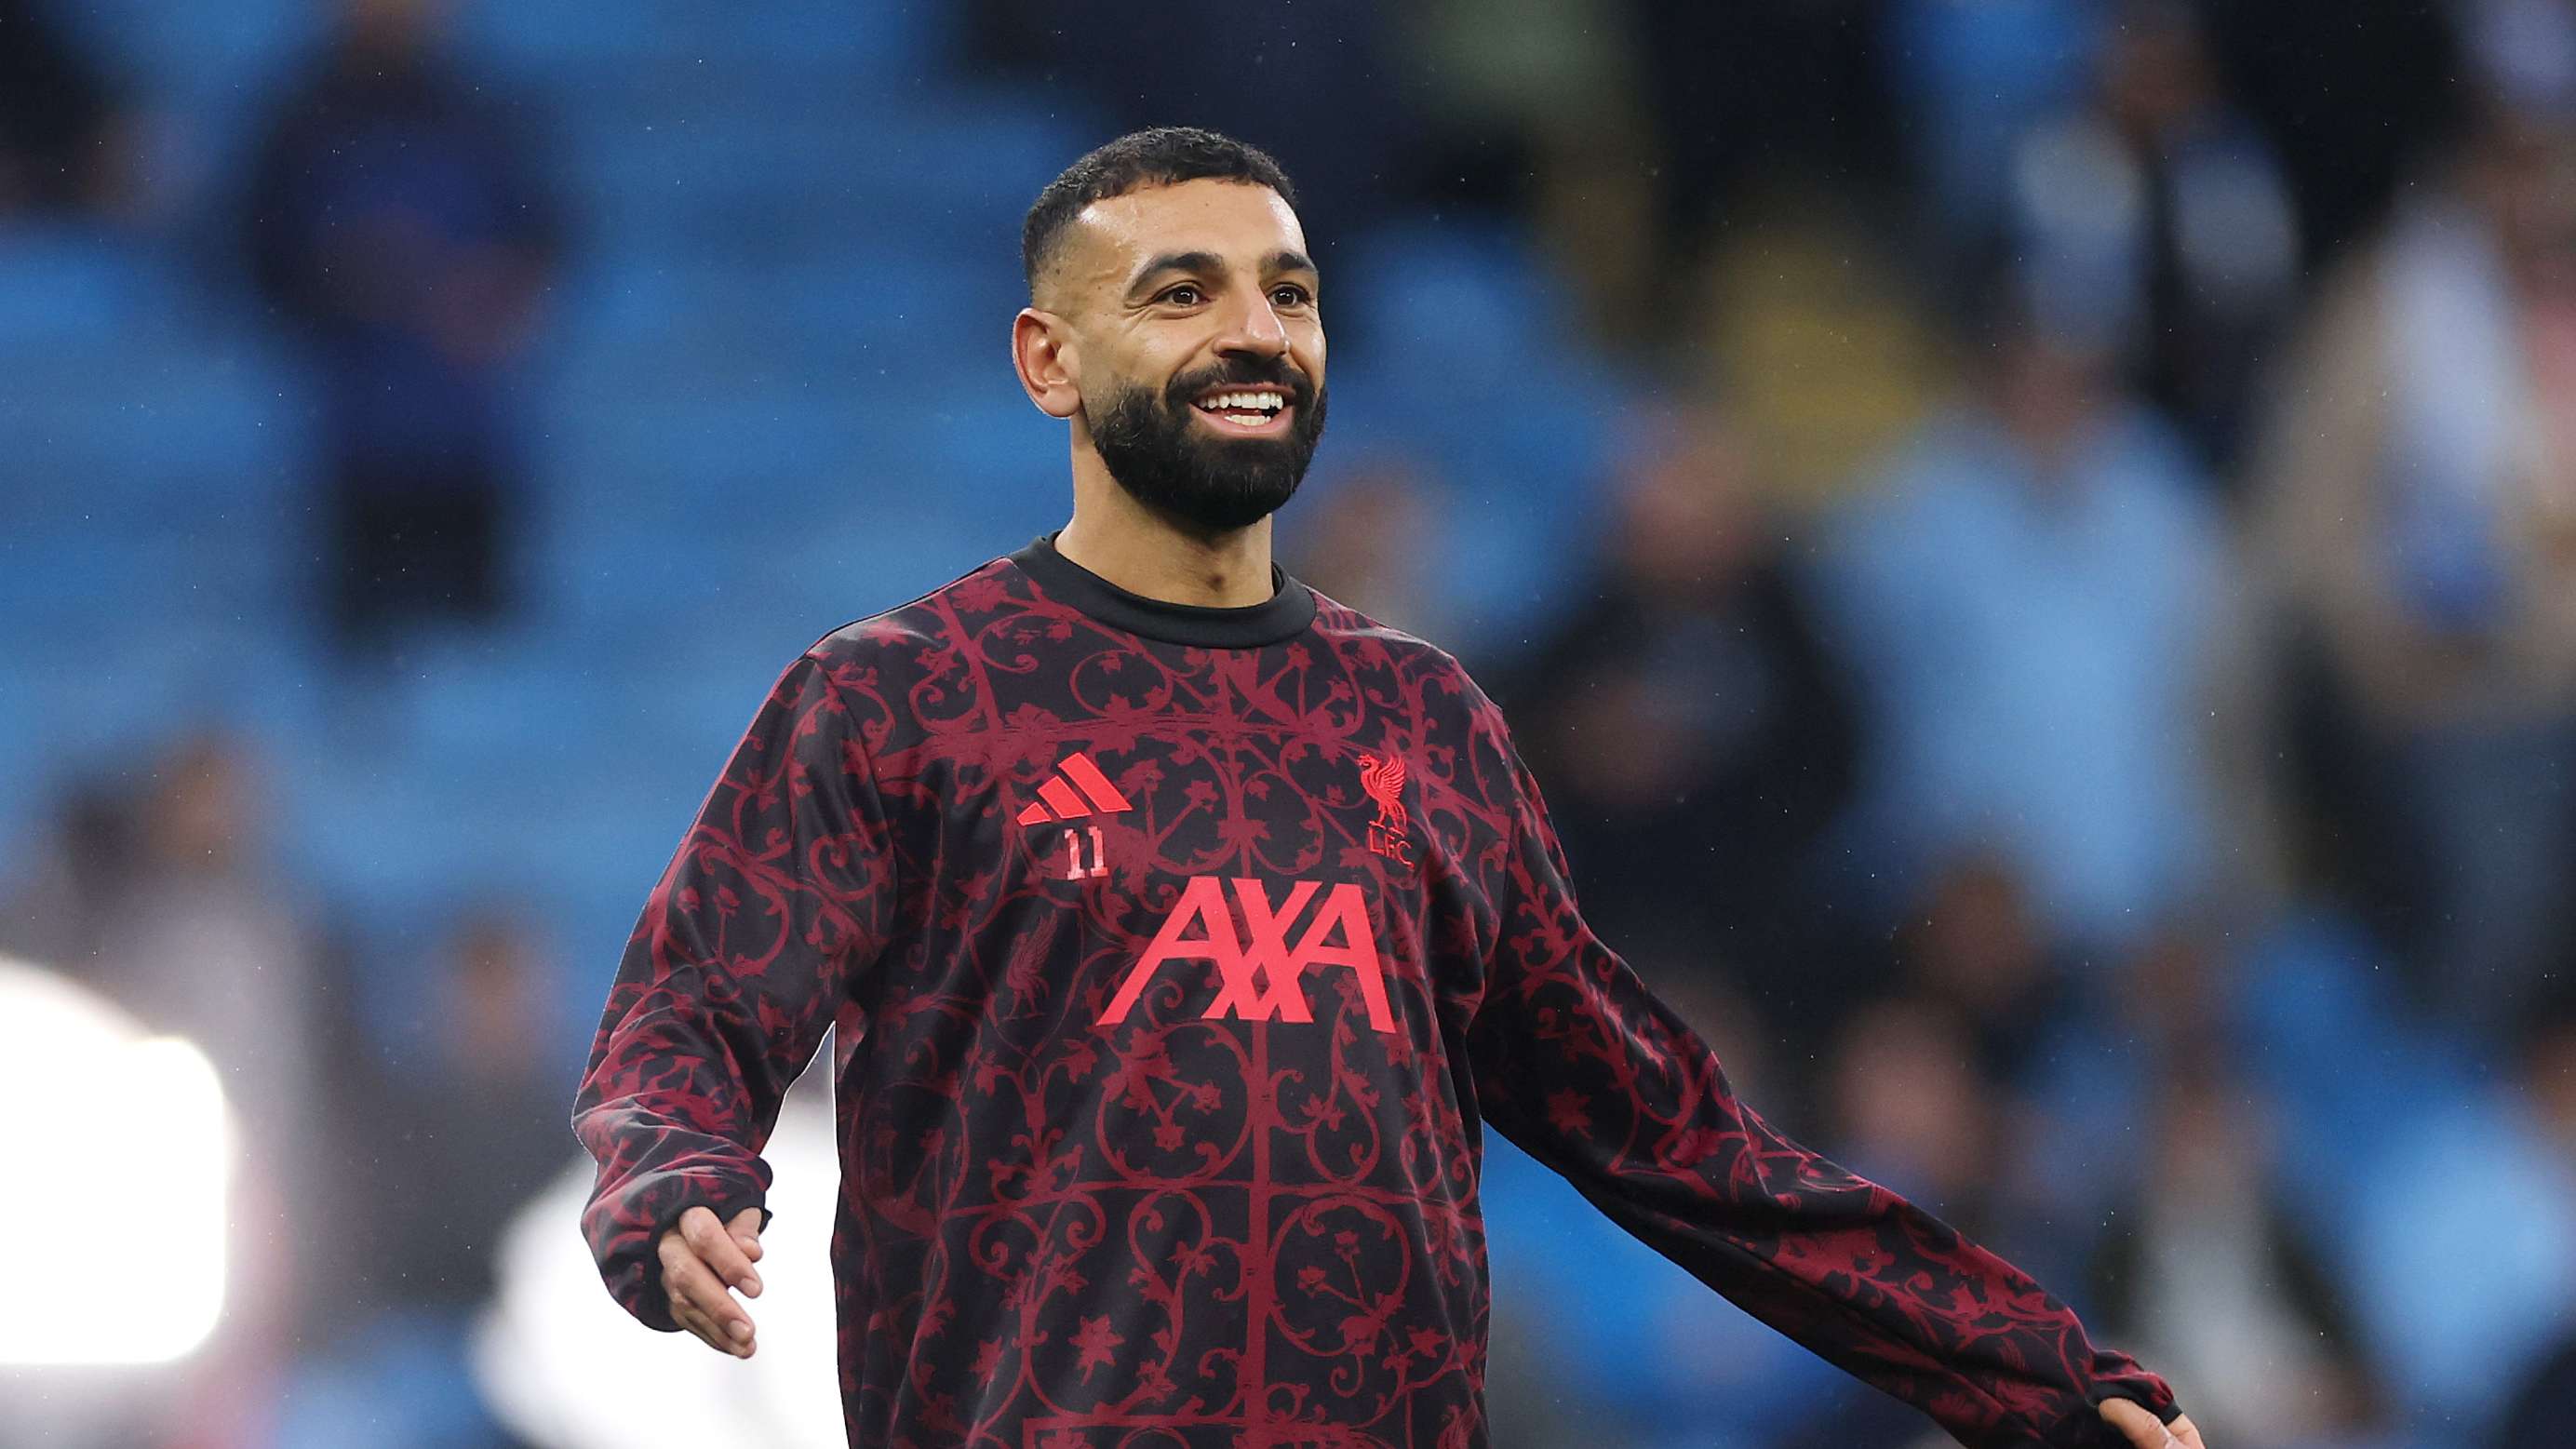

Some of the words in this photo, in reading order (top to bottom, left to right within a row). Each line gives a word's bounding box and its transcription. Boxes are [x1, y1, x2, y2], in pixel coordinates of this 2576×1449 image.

[1064, 826, 1108, 879] 11
[1368, 827, 1415, 867] LFC
[1096, 877, 1396, 1034] AXA
